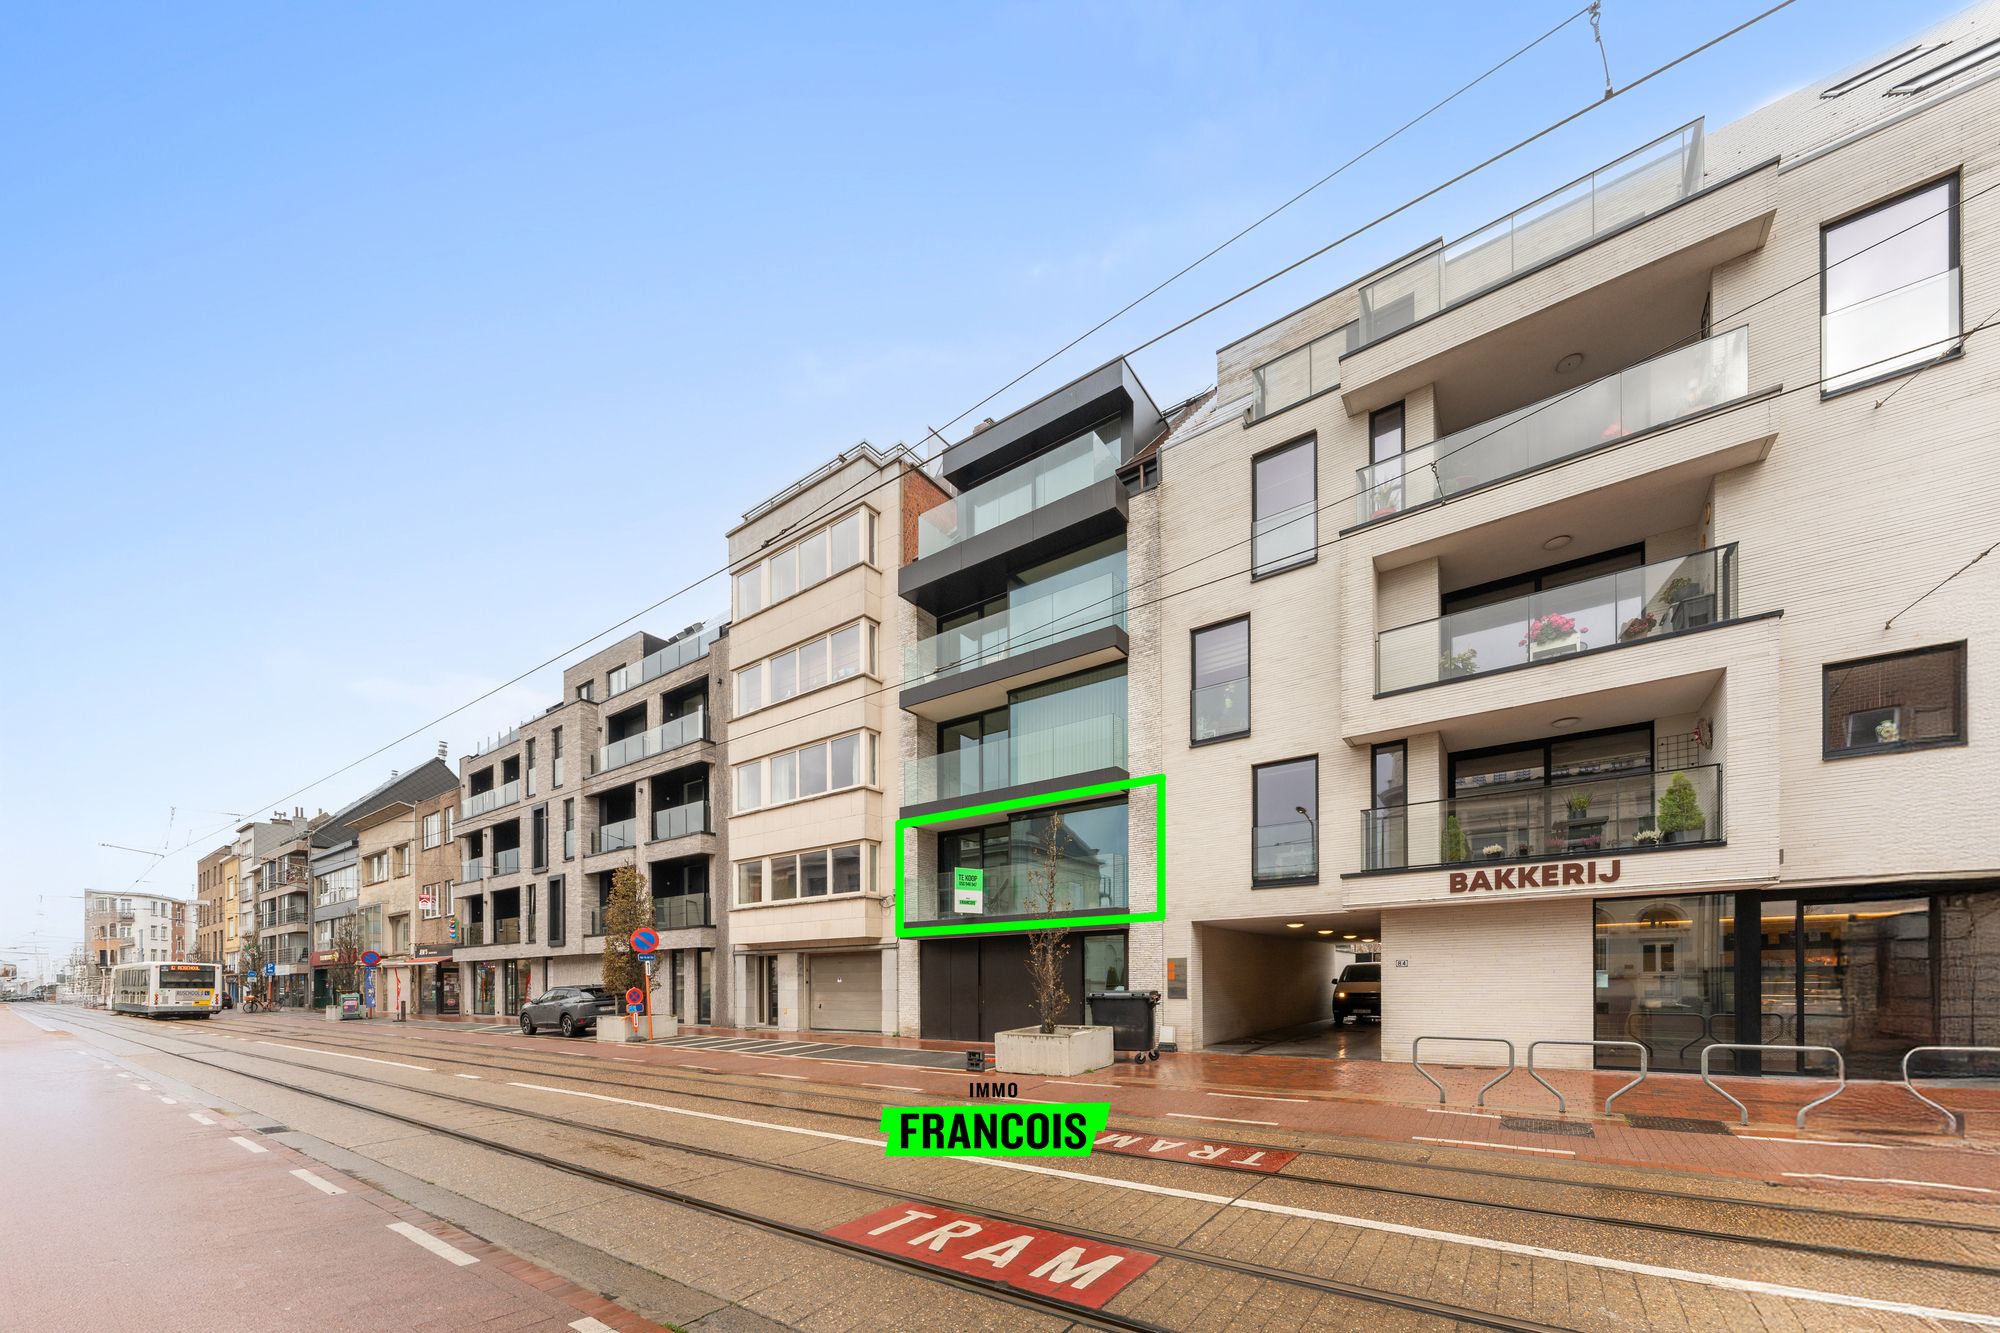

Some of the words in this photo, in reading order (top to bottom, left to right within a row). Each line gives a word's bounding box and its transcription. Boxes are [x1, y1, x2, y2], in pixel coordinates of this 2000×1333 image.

[1449, 859, 1621, 894] BAKKERIJ
[1092, 1133, 1266, 1167] TRAM
[866, 1209, 1125, 1290] TRAM
